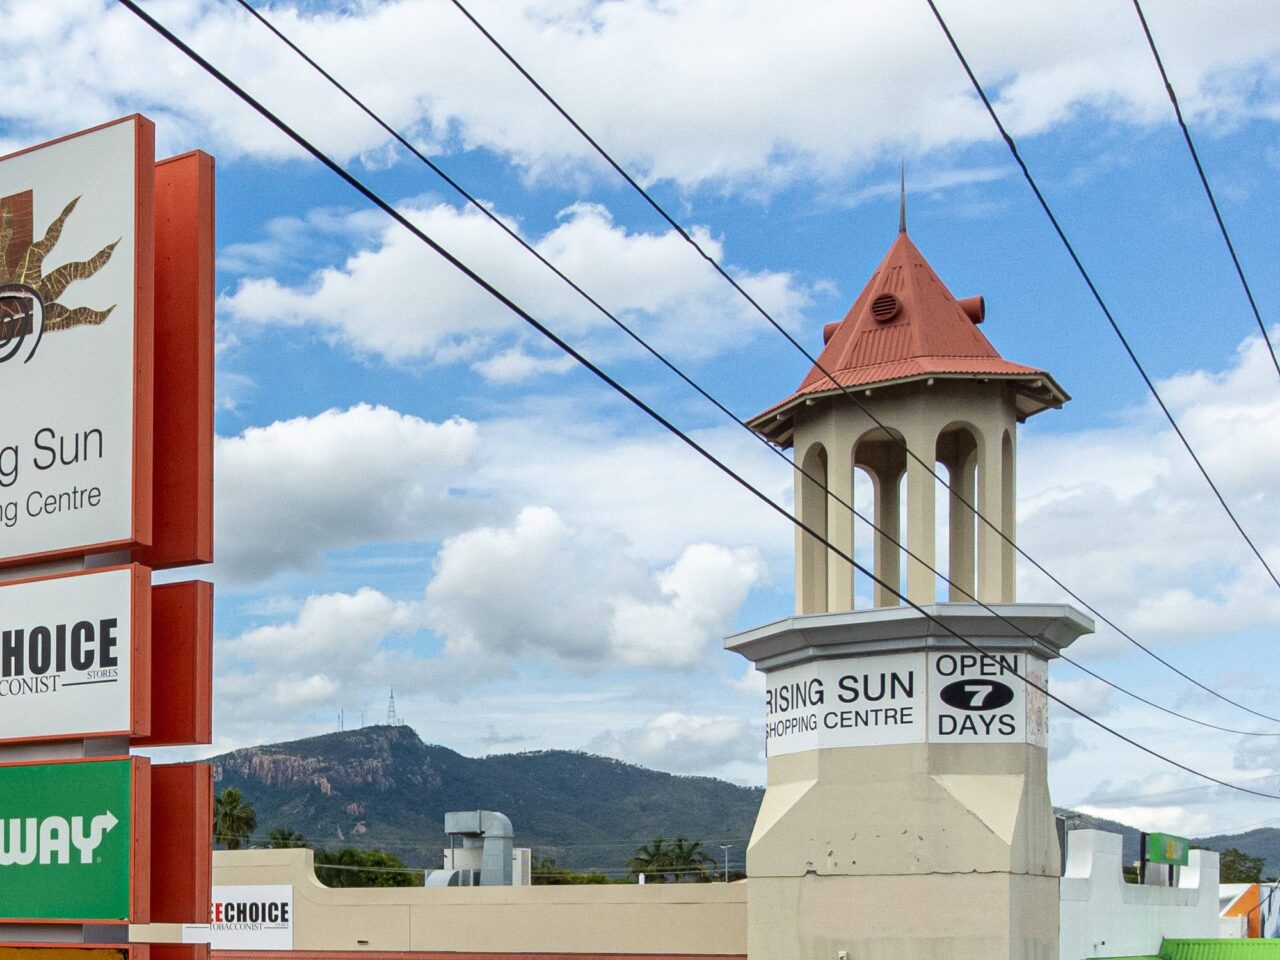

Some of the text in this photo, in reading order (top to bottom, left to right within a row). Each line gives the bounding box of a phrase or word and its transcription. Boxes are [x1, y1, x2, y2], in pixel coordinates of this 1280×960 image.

[33, 427, 104, 472] Sun
[26, 487, 102, 518] Centre
[86, 668, 119, 681] STORES
[936, 654, 1018, 676] OPEN
[766, 670, 914, 715] RISING SUN
[964, 684, 993, 707] 7
[823, 706, 913, 729] CENTRE
[938, 714, 1016, 736] DAYS
[209, 902, 289, 923] ECHOICE
